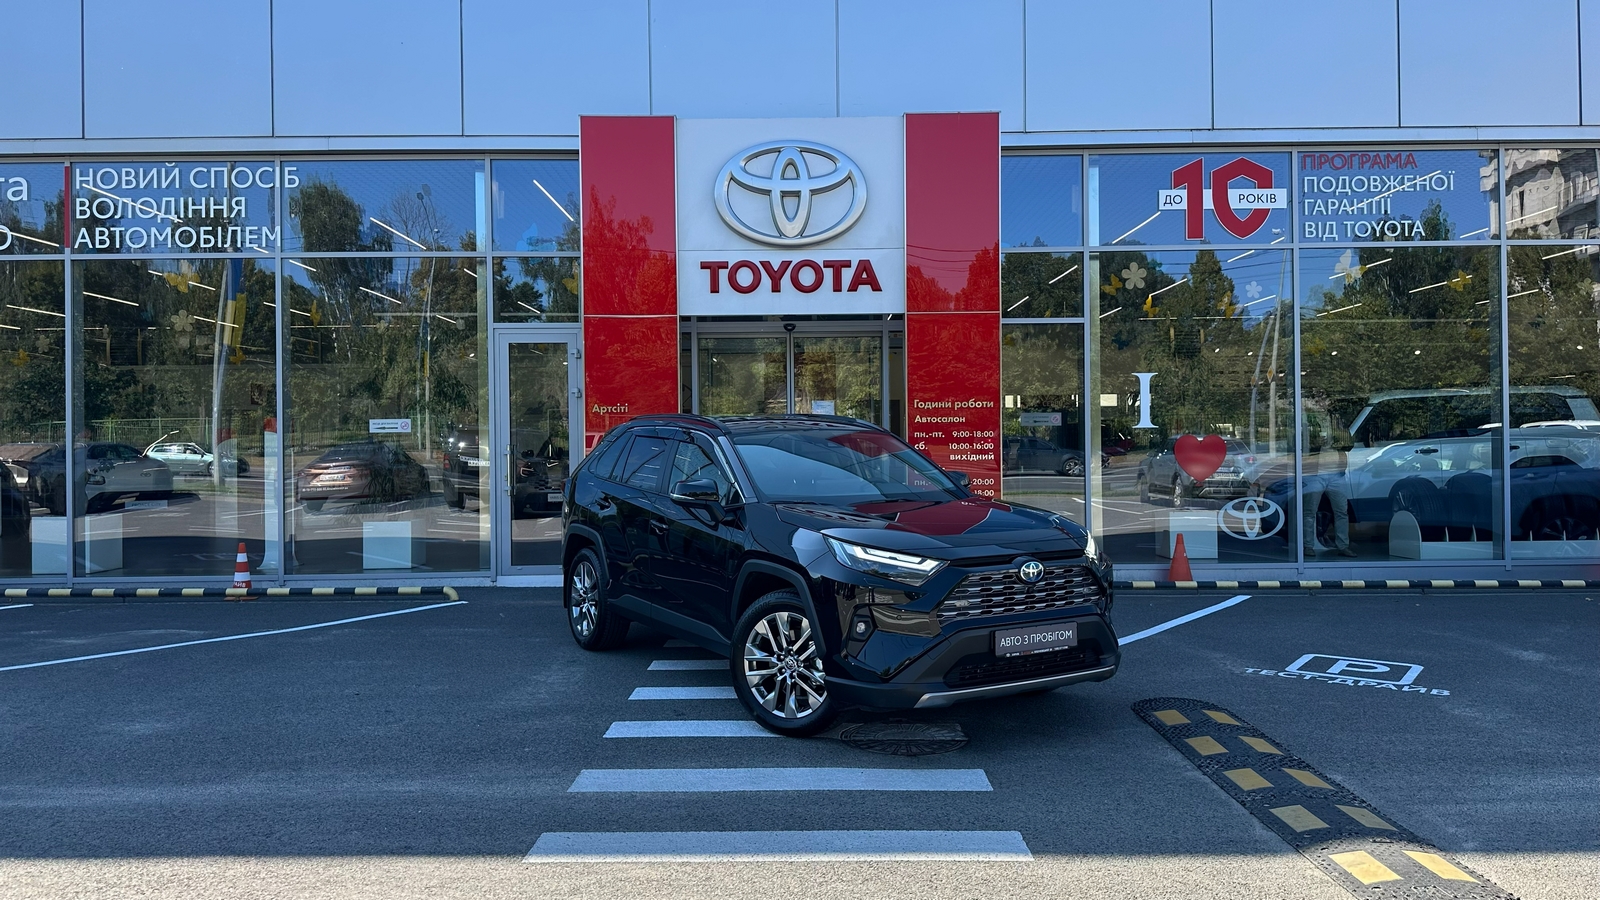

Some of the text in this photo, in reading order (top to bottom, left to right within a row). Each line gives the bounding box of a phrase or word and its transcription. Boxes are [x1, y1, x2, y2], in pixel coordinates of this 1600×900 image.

[1302, 152, 1418, 170] ПРОГРАМА
[75, 162, 300, 190] НОВИЙ СПОСІБ
[1304, 170, 1455, 196] ПОДОВЖЕНОЇ
[1163, 194, 1183, 206] ДО
[1238, 193, 1277, 204] РОКІВ
[1304, 194, 1393, 216] ГАРАНТІЇ
[75, 196, 246, 223] ВОЛОДІННЯ
[74, 225, 281, 249] АВТОМОБІЛЕМ
[1305, 220, 1426, 241] ВІД TOYOTA
[700, 259, 883, 294] TOYOTA
[592, 403, 628, 415] Артсіті
[914, 398, 994, 410] Години роботи
[1132, 372, 1159, 429] I
[914, 415, 966, 423] Автосалон
[952, 430, 994, 438] 9:00-18:00
[914, 441, 994, 450] сб. 10:00-16:00
[950, 451, 995, 461] вихідний
[970, 478, 995, 486] -20:00
[1000, 630, 1073, 647] АВТО З ПРОБІГОМ
[1244, 667, 1451, 697] ТЕСТ-ДРАЙВ
